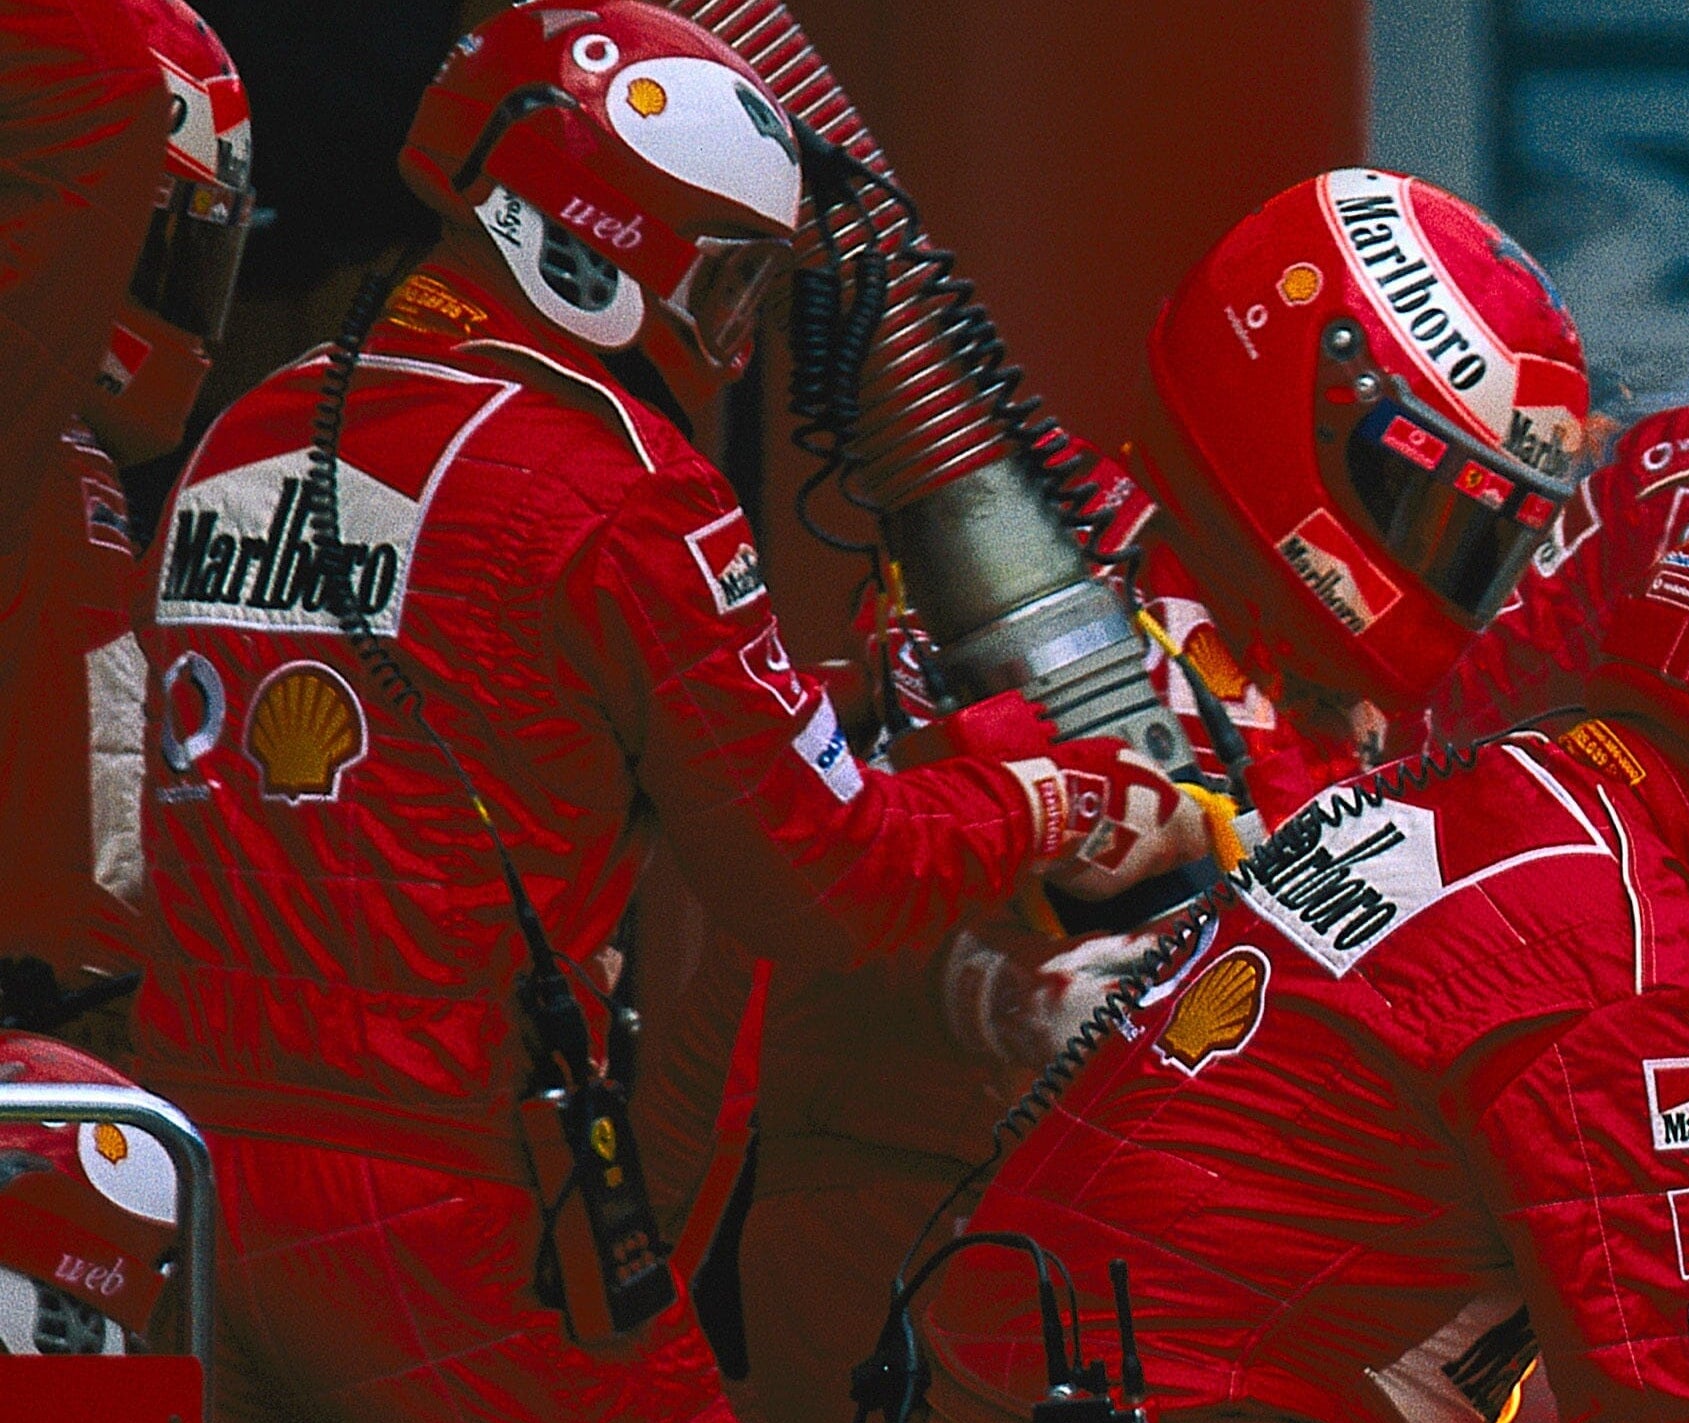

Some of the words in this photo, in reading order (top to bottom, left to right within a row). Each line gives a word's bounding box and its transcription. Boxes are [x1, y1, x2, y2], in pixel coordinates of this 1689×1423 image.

[560, 195, 644, 250] web
[1336, 194, 1488, 393] Marlboro
[1280, 536, 1366, 633] Marlboro
[53, 1254, 127, 1294] web
